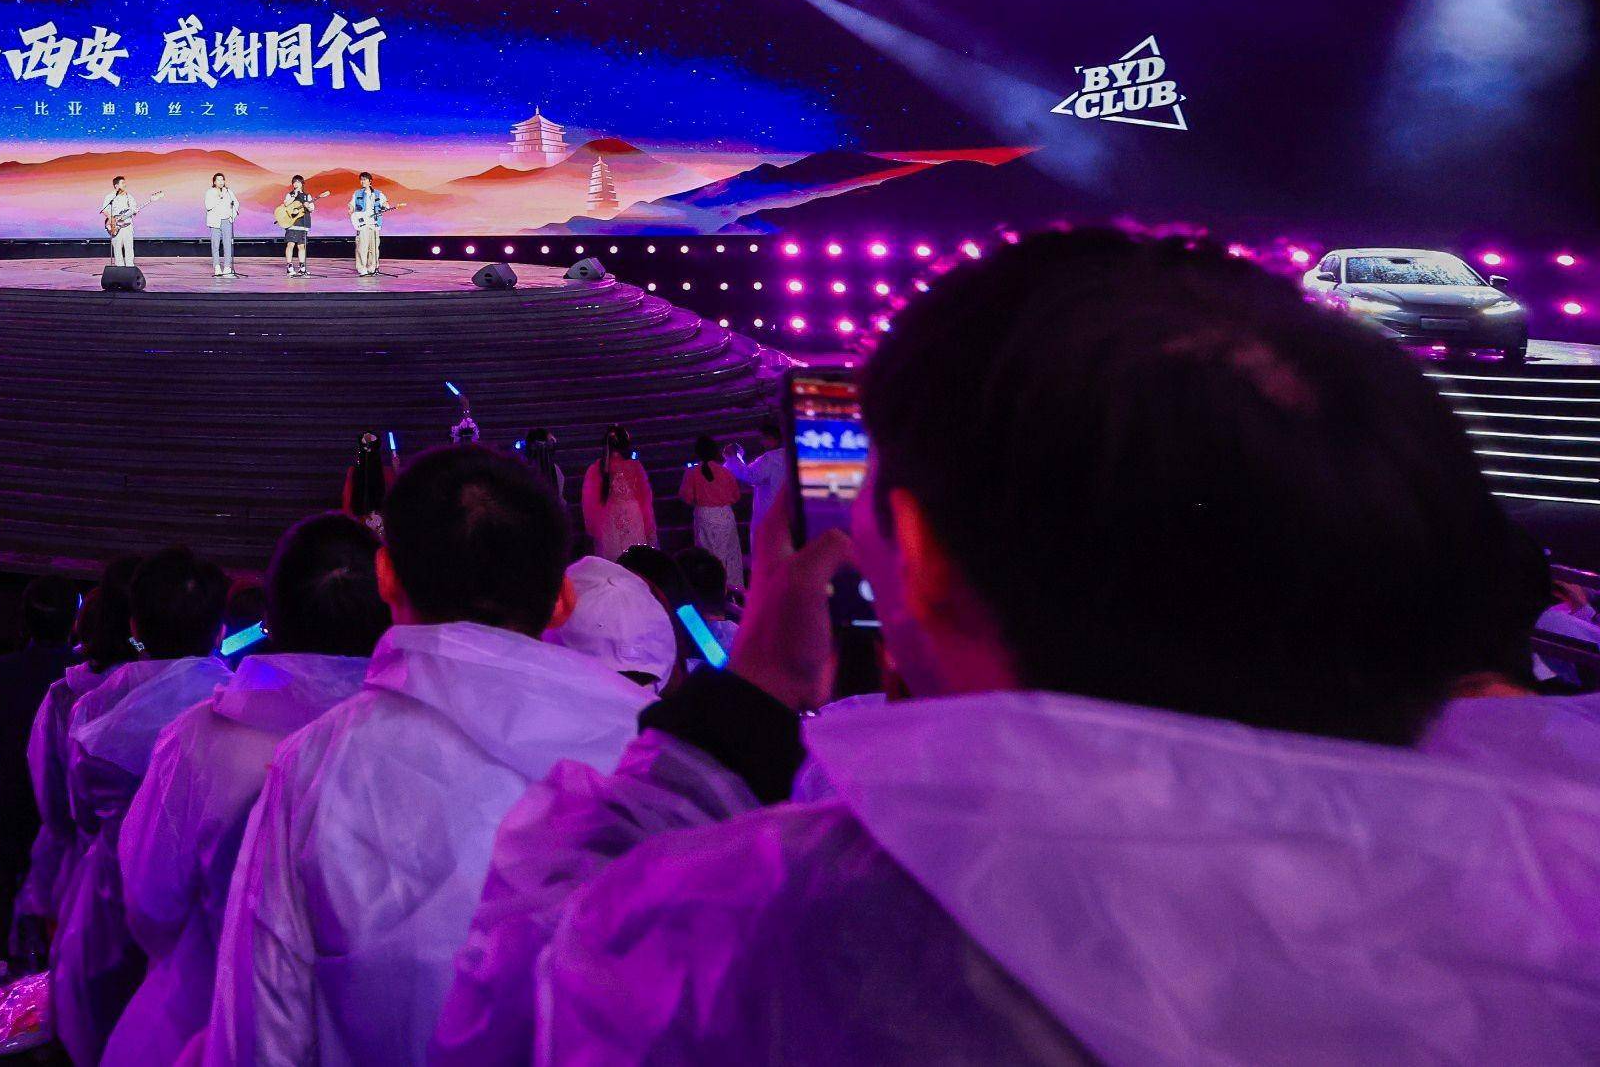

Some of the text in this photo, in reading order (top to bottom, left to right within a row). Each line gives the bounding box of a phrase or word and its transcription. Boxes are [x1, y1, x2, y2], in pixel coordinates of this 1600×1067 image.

[151, 12, 387, 92] 感谢同行
[1081, 56, 1166, 93] BYD
[1074, 80, 1178, 119] CLUB
